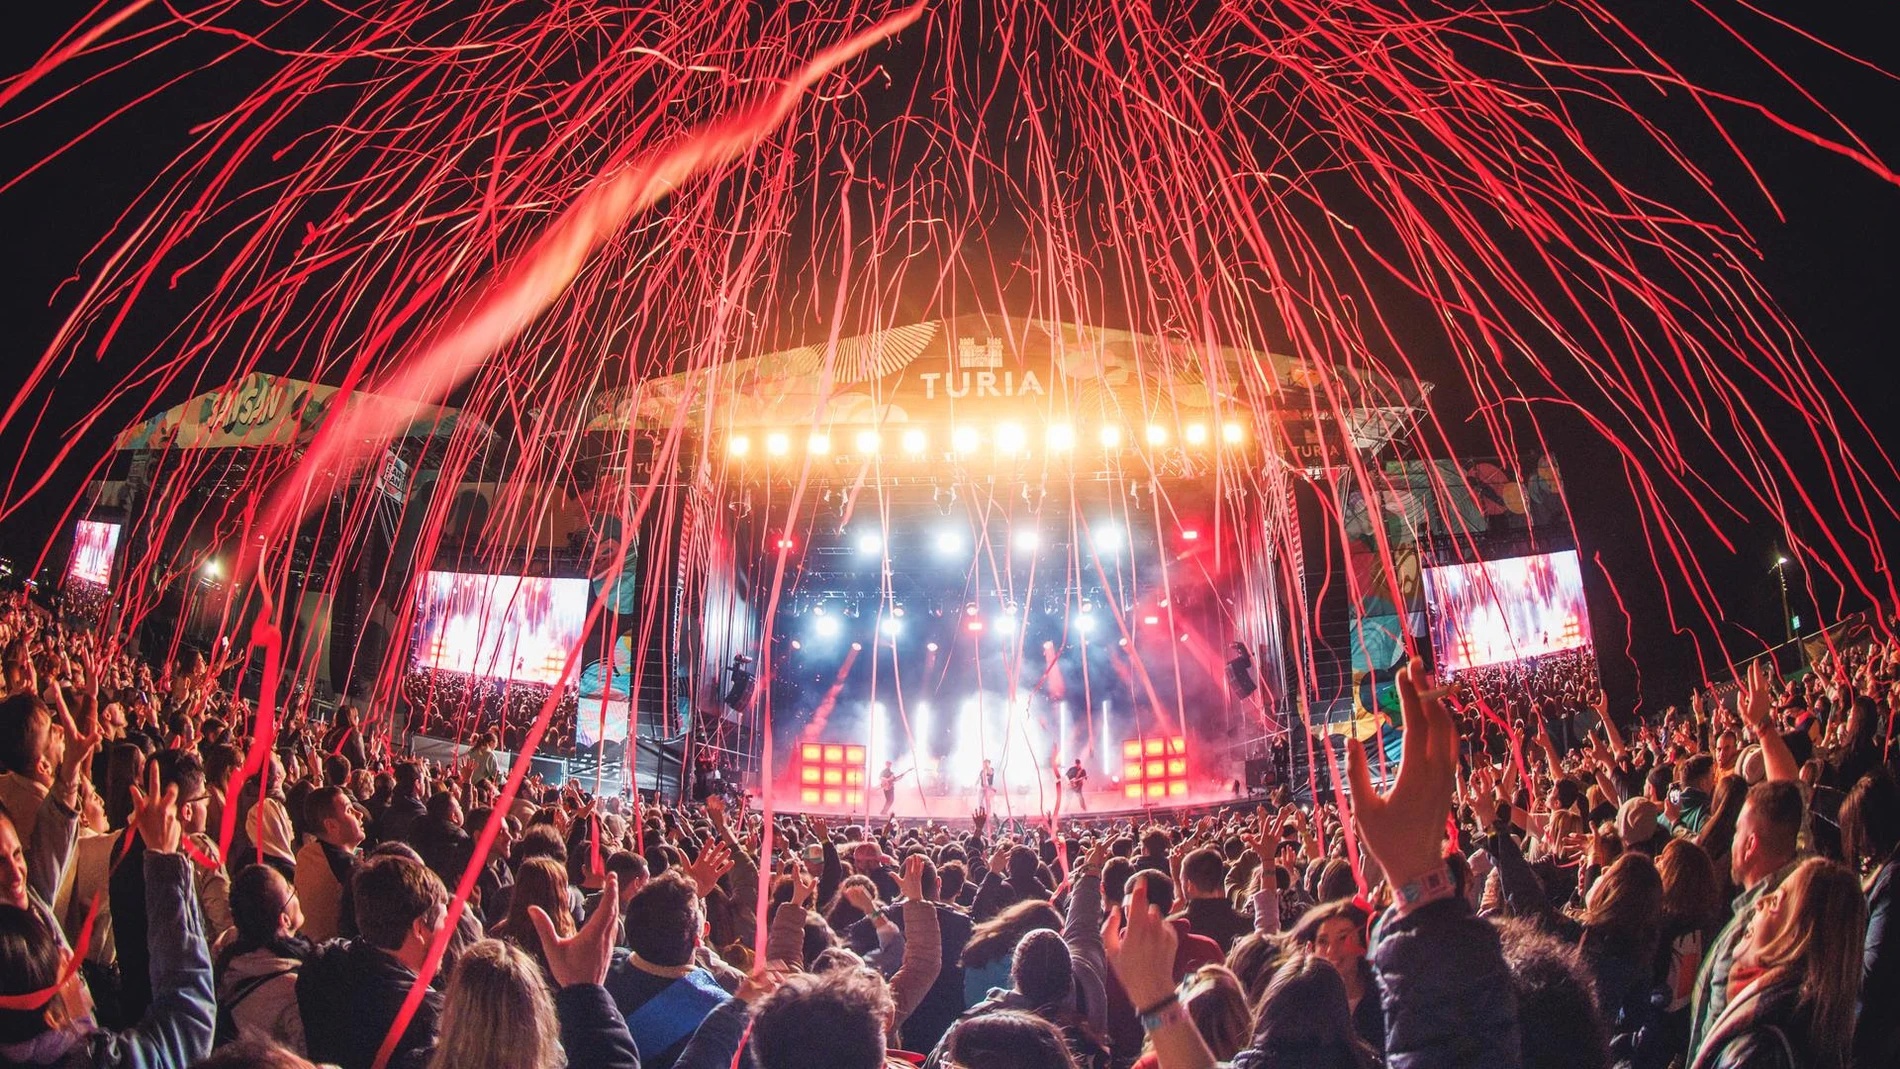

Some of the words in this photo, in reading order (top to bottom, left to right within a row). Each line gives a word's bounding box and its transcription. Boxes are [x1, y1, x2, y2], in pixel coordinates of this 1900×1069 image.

[920, 371, 1045, 399] TURIA
[1291, 445, 1340, 457] TURA
[636, 462, 683, 473] TUA
